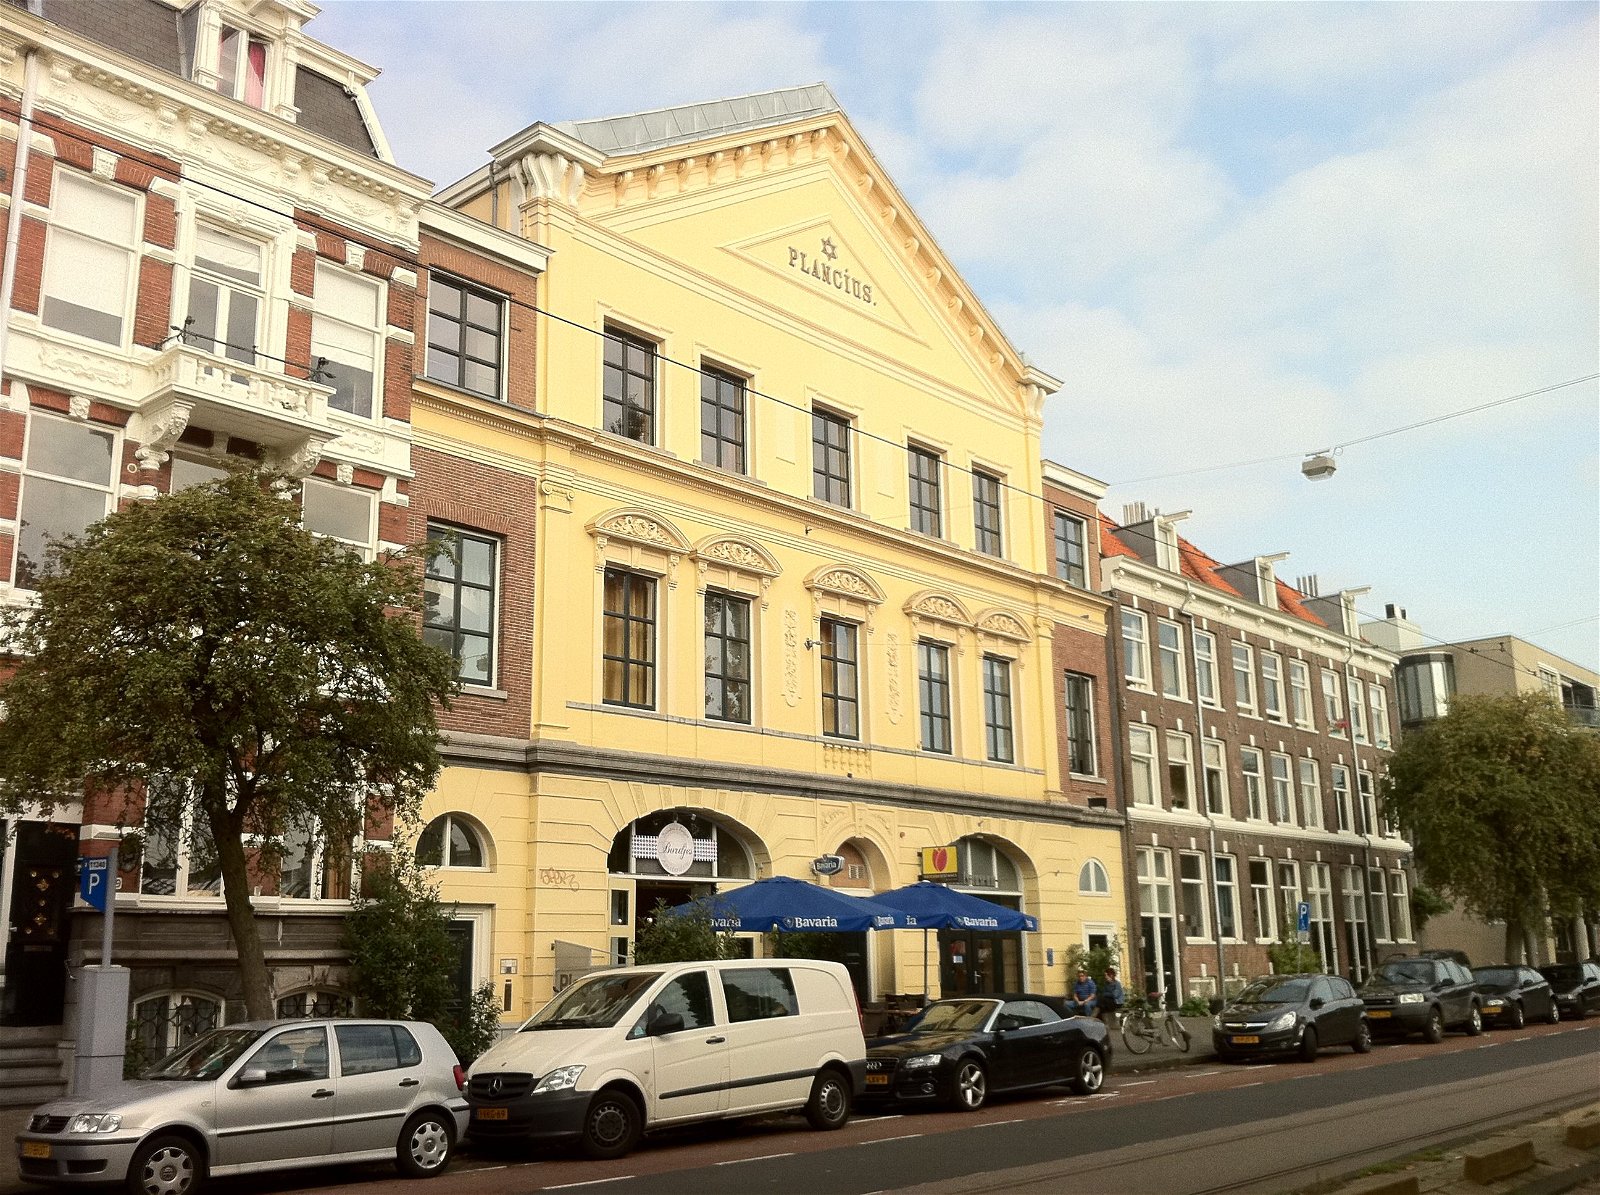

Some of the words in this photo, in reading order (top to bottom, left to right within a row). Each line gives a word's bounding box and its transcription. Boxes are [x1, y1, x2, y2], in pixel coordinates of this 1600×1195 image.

[88, 873, 100, 894] P
[1300, 905, 1307, 918] P
[795, 916, 837, 928] Bavaria
[963, 916, 998, 927] Bavaria
